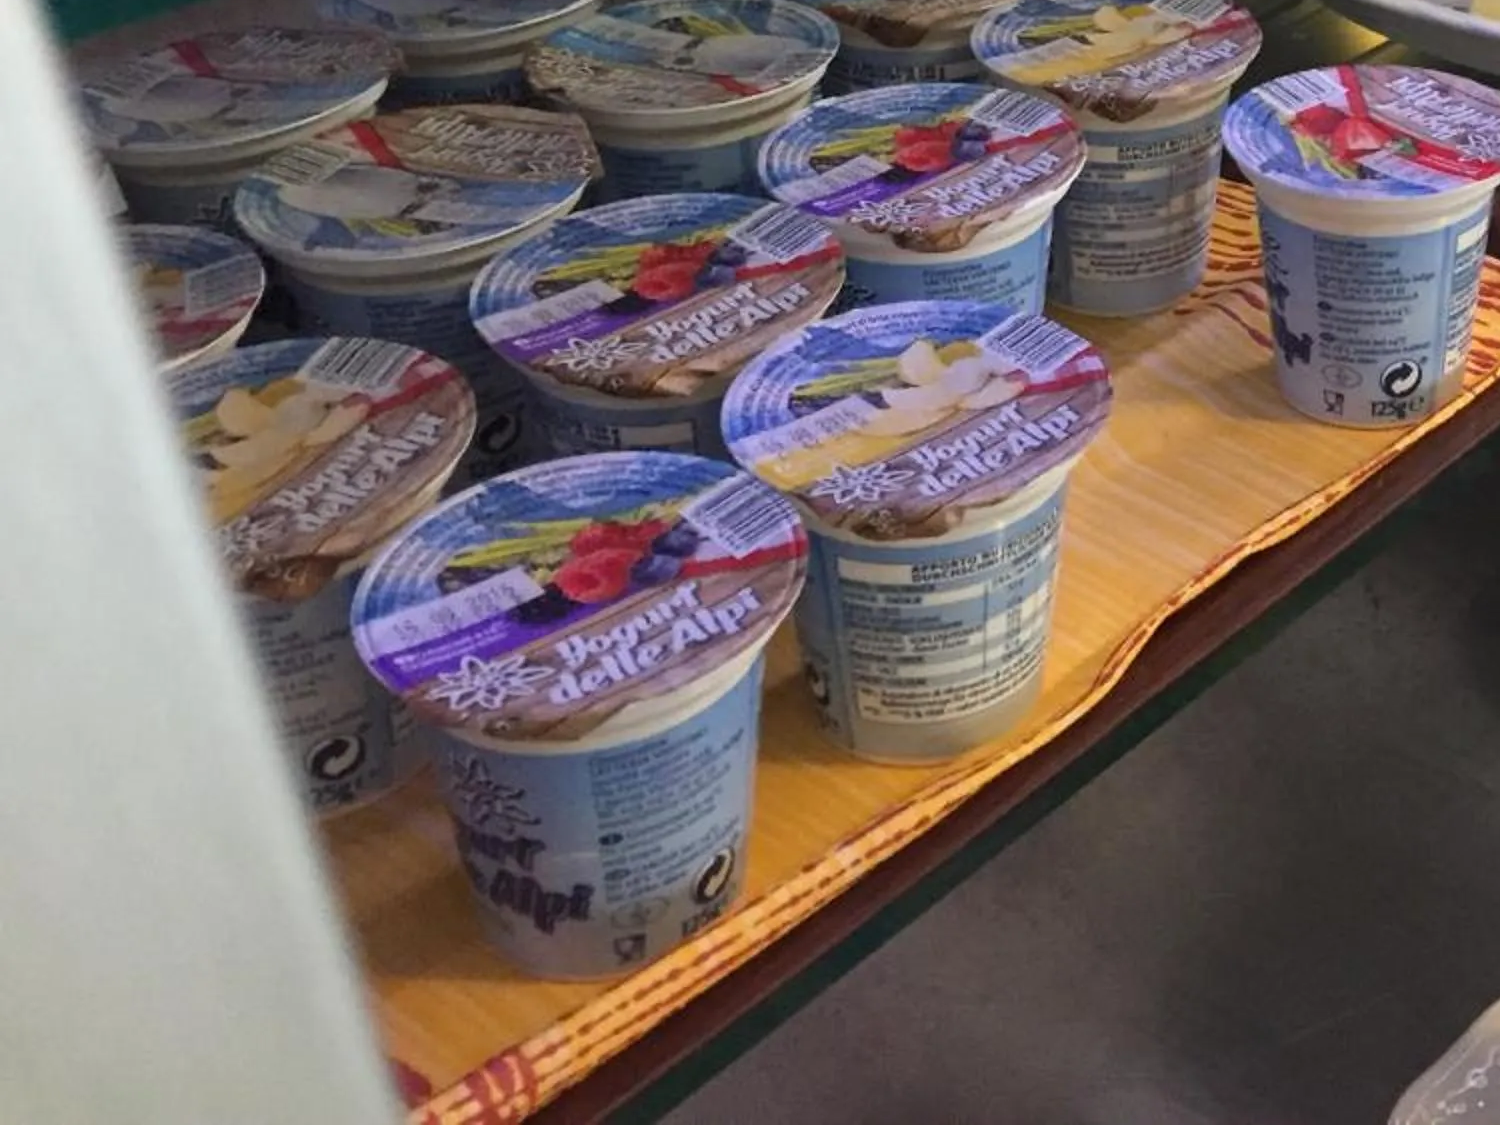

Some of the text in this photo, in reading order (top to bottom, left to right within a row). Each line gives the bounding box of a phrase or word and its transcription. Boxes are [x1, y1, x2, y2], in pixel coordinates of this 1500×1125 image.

[908, 400, 1024, 472] Yogurt
[917, 404, 1081, 496] delle Alpi
[550, 643, 665, 704] delle
[671, 587, 761, 653] Alpi
[555, 580, 699, 668] Yogurt
